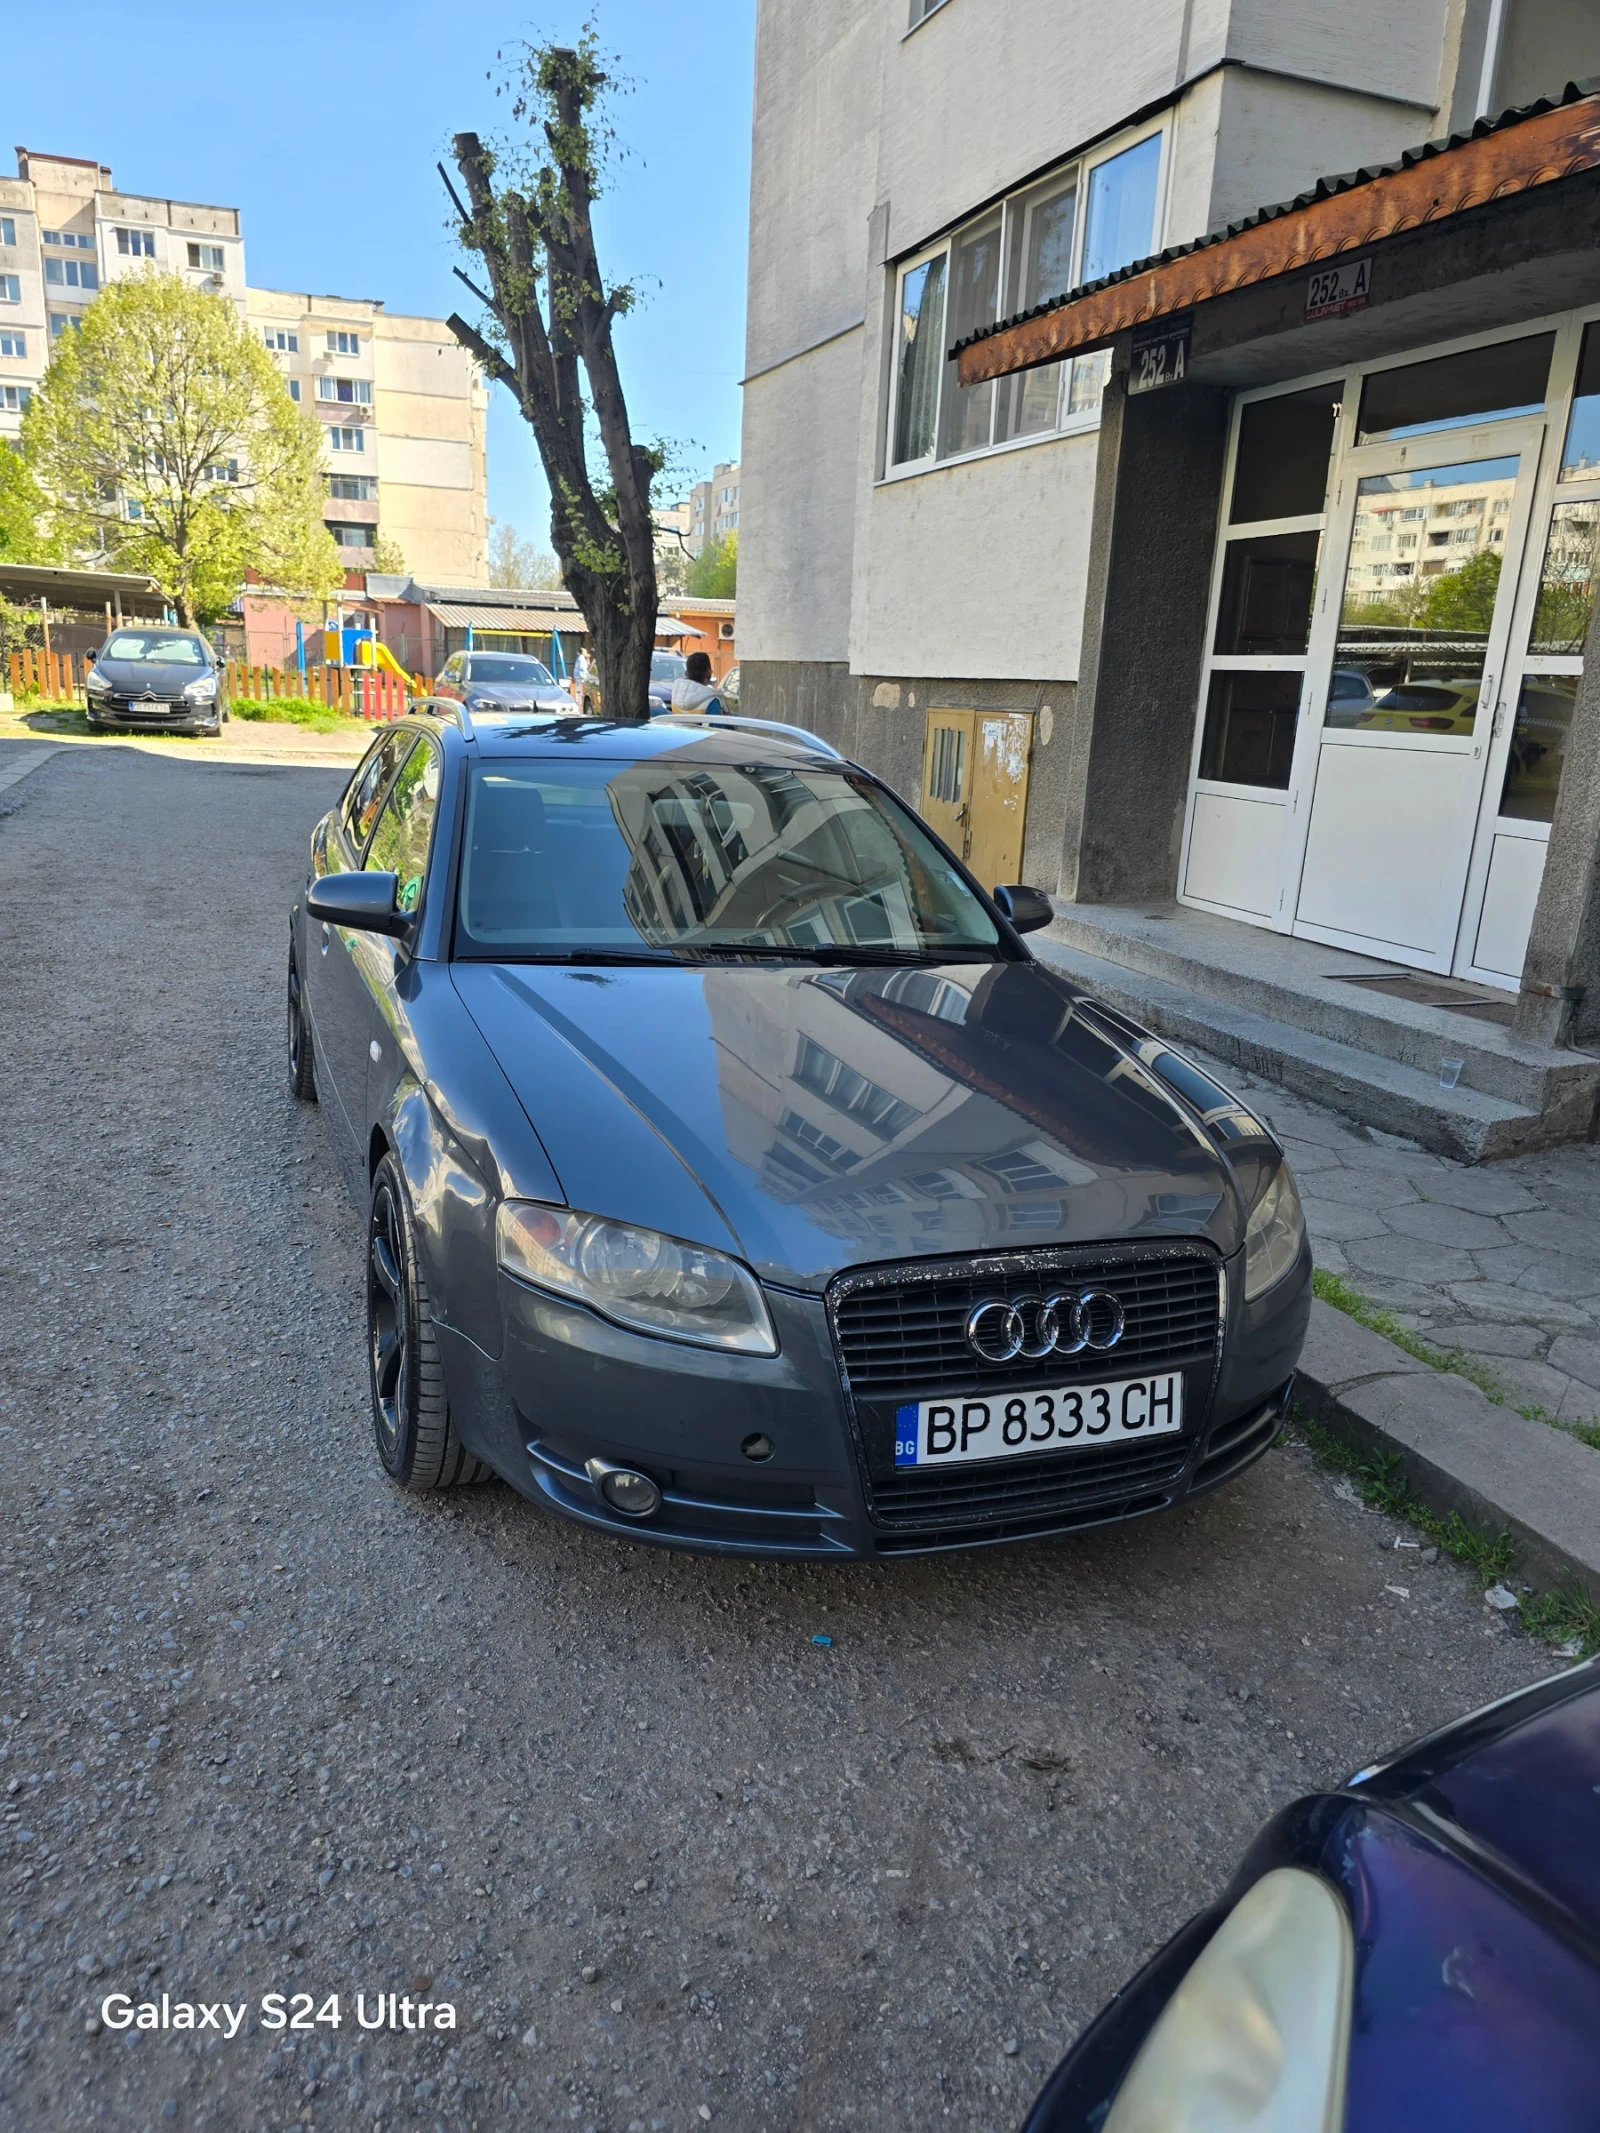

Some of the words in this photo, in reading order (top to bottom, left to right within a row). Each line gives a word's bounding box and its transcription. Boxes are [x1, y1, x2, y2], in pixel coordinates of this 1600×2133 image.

[1310, 271, 1339, 307] 252
[1138, 345, 1166, 389] 252
[926, 1403, 990, 1455] BP
[1002, 1388, 1111, 1446] 8333
[1121, 1377, 1174, 1430] CH
[895, 1440, 915, 1456] BG
